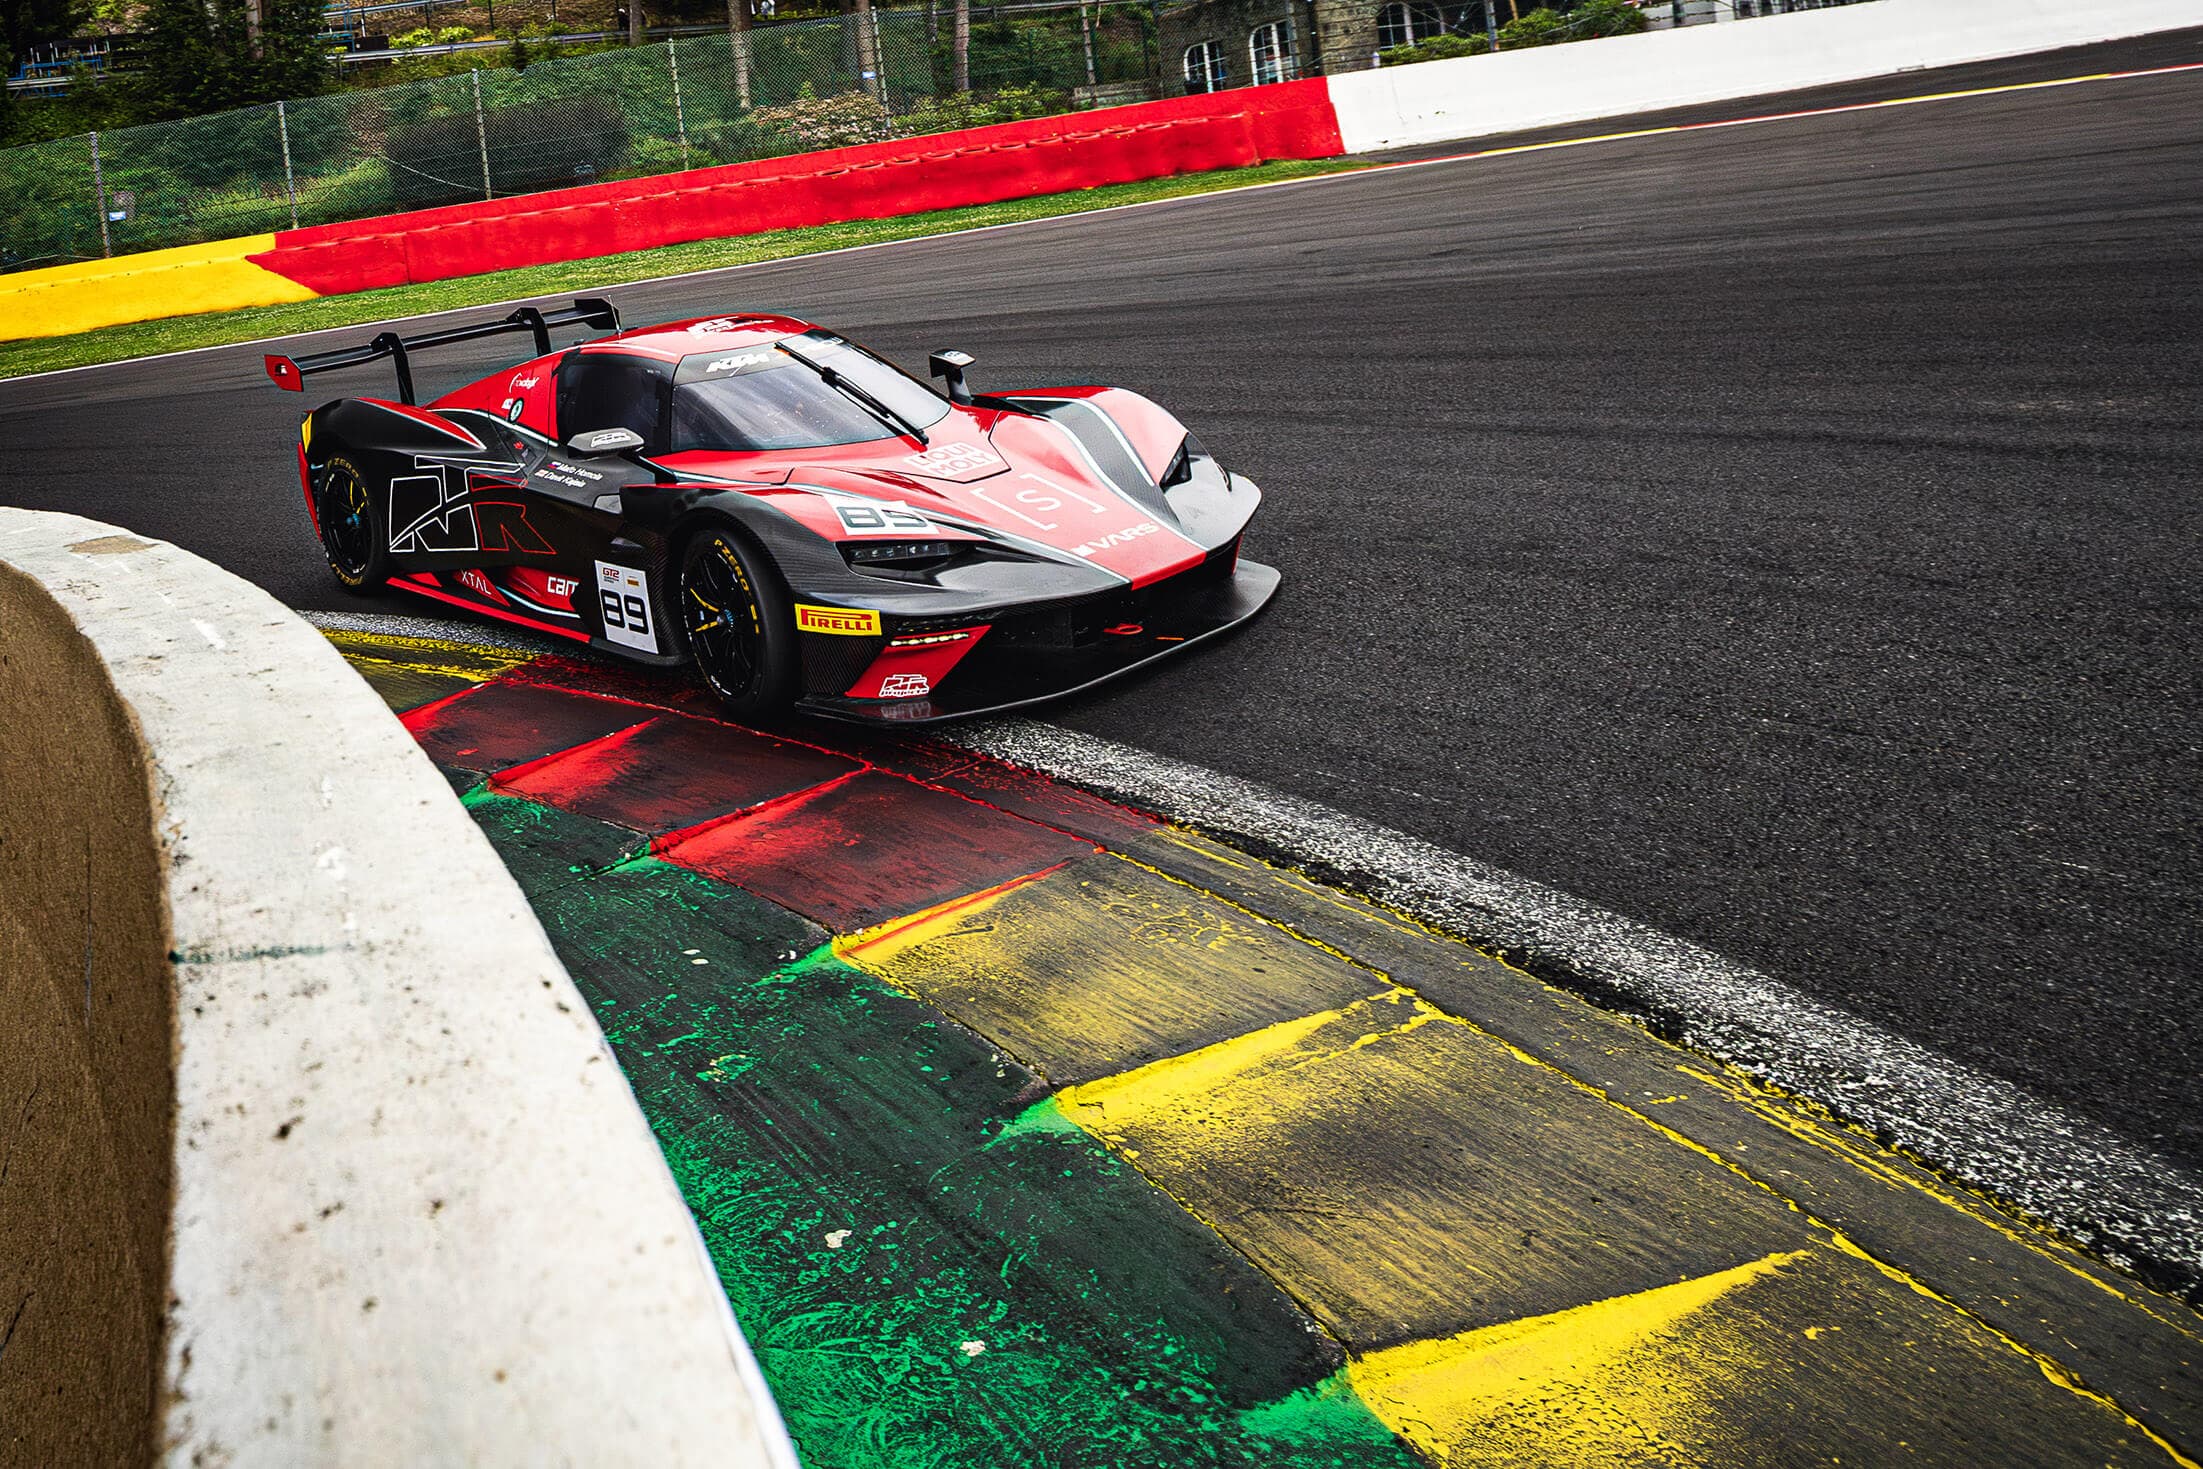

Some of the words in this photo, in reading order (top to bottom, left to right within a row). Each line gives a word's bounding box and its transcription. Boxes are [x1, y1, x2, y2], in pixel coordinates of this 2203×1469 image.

[706, 353, 769, 374] KTM
[909, 444, 975, 466] LIQUI
[930, 453, 993, 475] MOLY
[603, 567, 620, 579] GT2
[722, 545, 750, 592] ZERO
[600, 588, 649, 635] 89
[800, 608, 873, 631] PIRELLI
